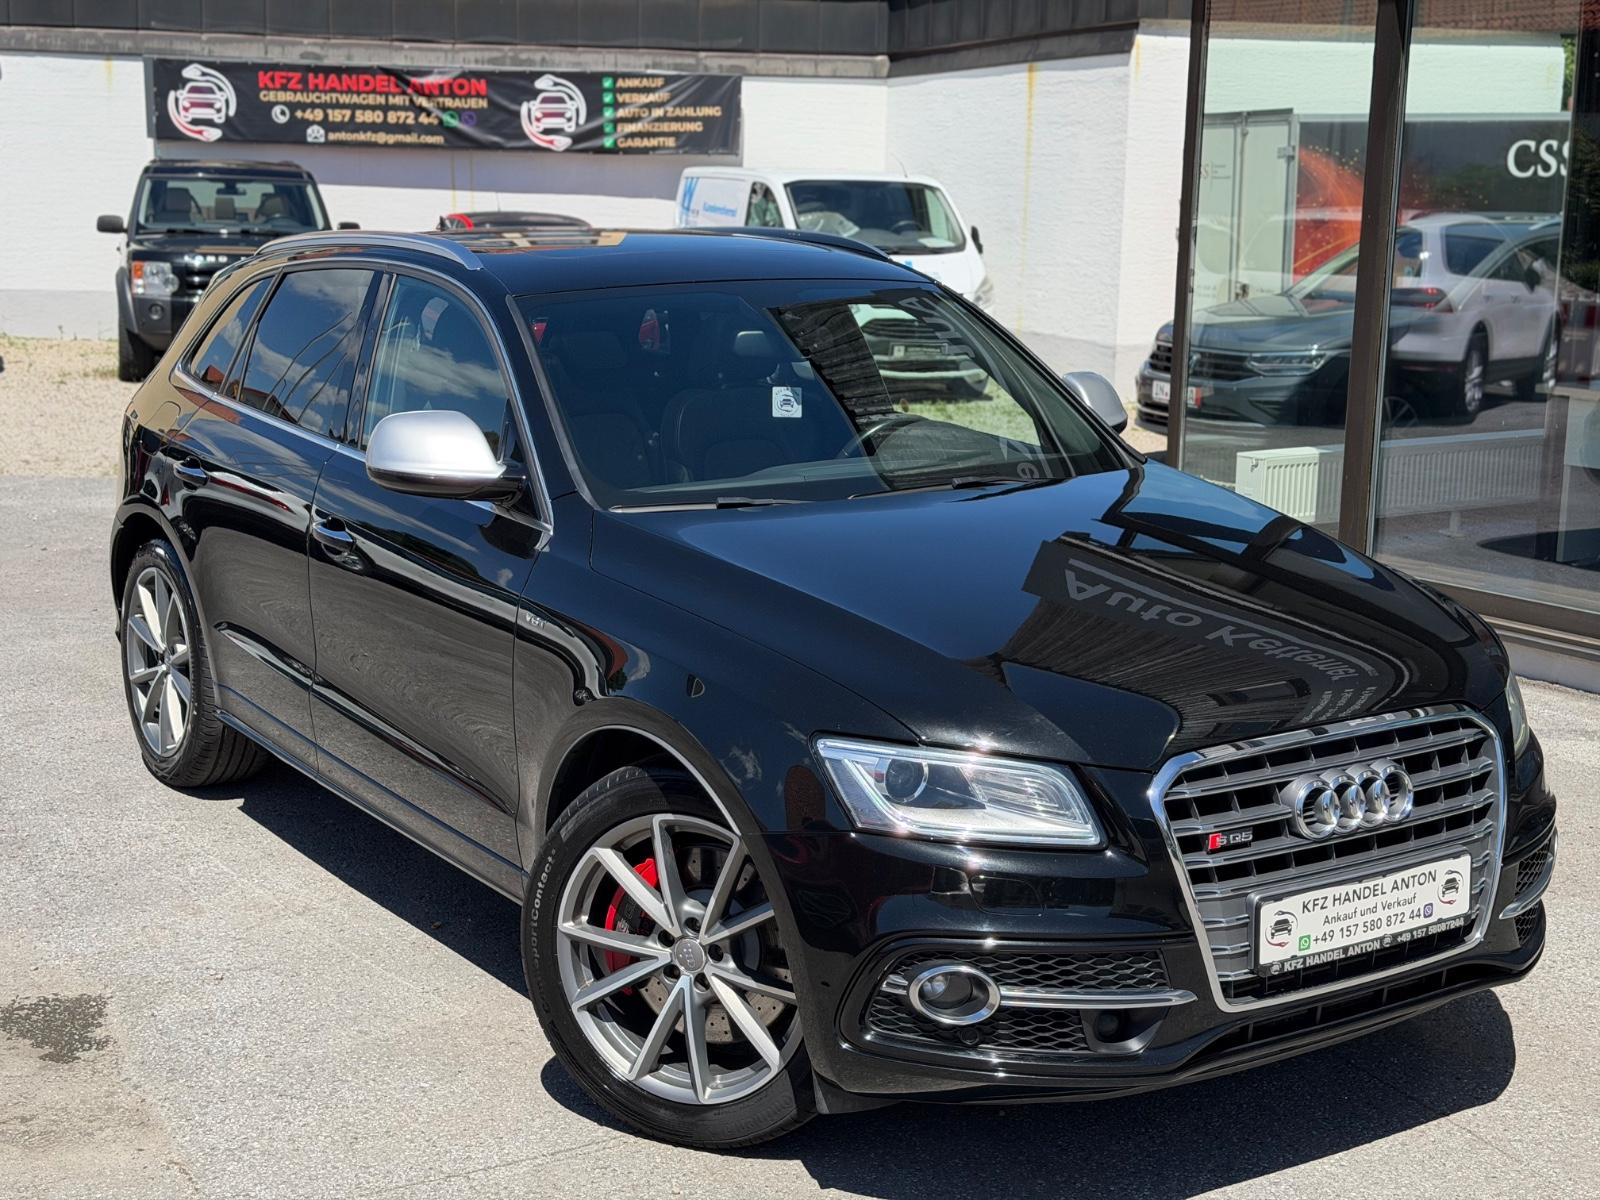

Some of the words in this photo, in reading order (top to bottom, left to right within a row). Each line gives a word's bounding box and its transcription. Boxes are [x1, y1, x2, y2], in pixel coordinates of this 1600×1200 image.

[258, 71, 302, 90] KFZ
[308, 73, 402, 93] HANDEL
[408, 77, 488, 97] ANTON
[616, 77, 665, 88] ANKAUF
[259, 90, 386, 106] GEBRAUCHTWAGEN
[388, 96, 409, 106] MIT
[616, 92, 672, 103] VERKAUF
[295, 108, 324, 122] +49
[326, 109, 352, 123] 157
[354, 109, 384, 124] 580
[386, 110, 416, 125] 872
[418, 112, 439, 125] 44
[616, 107, 649, 118] AUTO
[651, 107, 664, 117] IN
[666, 107, 722, 117] ZAHLUNG
[617, 122, 703, 133] FINANZIERUNG
[327, 130, 445, 144] antonkfz@gmail.com
[617, 136, 676, 148] GARANTIE
[1301, 895, 1328, 914] KFZ
[1332, 883, 1387, 908] HANDEL
[1390, 869, 1437, 893] ANTON
[1322, 909, 1358, 926] Ankauf
[1360, 904, 1378, 918] und
[1381, 893, 1417, 913] Verkauf
[1313, 929, 1335, 945] +49
[1339, 923, 1359, 939] 157
[1362, 918, 1383, 933] 580
[1386, 911, 1406, 927] 872
[1408, 907, 1422, 921] 44
[1283, 957, 1304, 971] KFZ
[1306, 946, 1346, 966] HANDEL
[1347, 939, 1381, 957] ANTON
[1397, 933, 1412, 943] +49
[1413, 928, 1427, 940] 157
